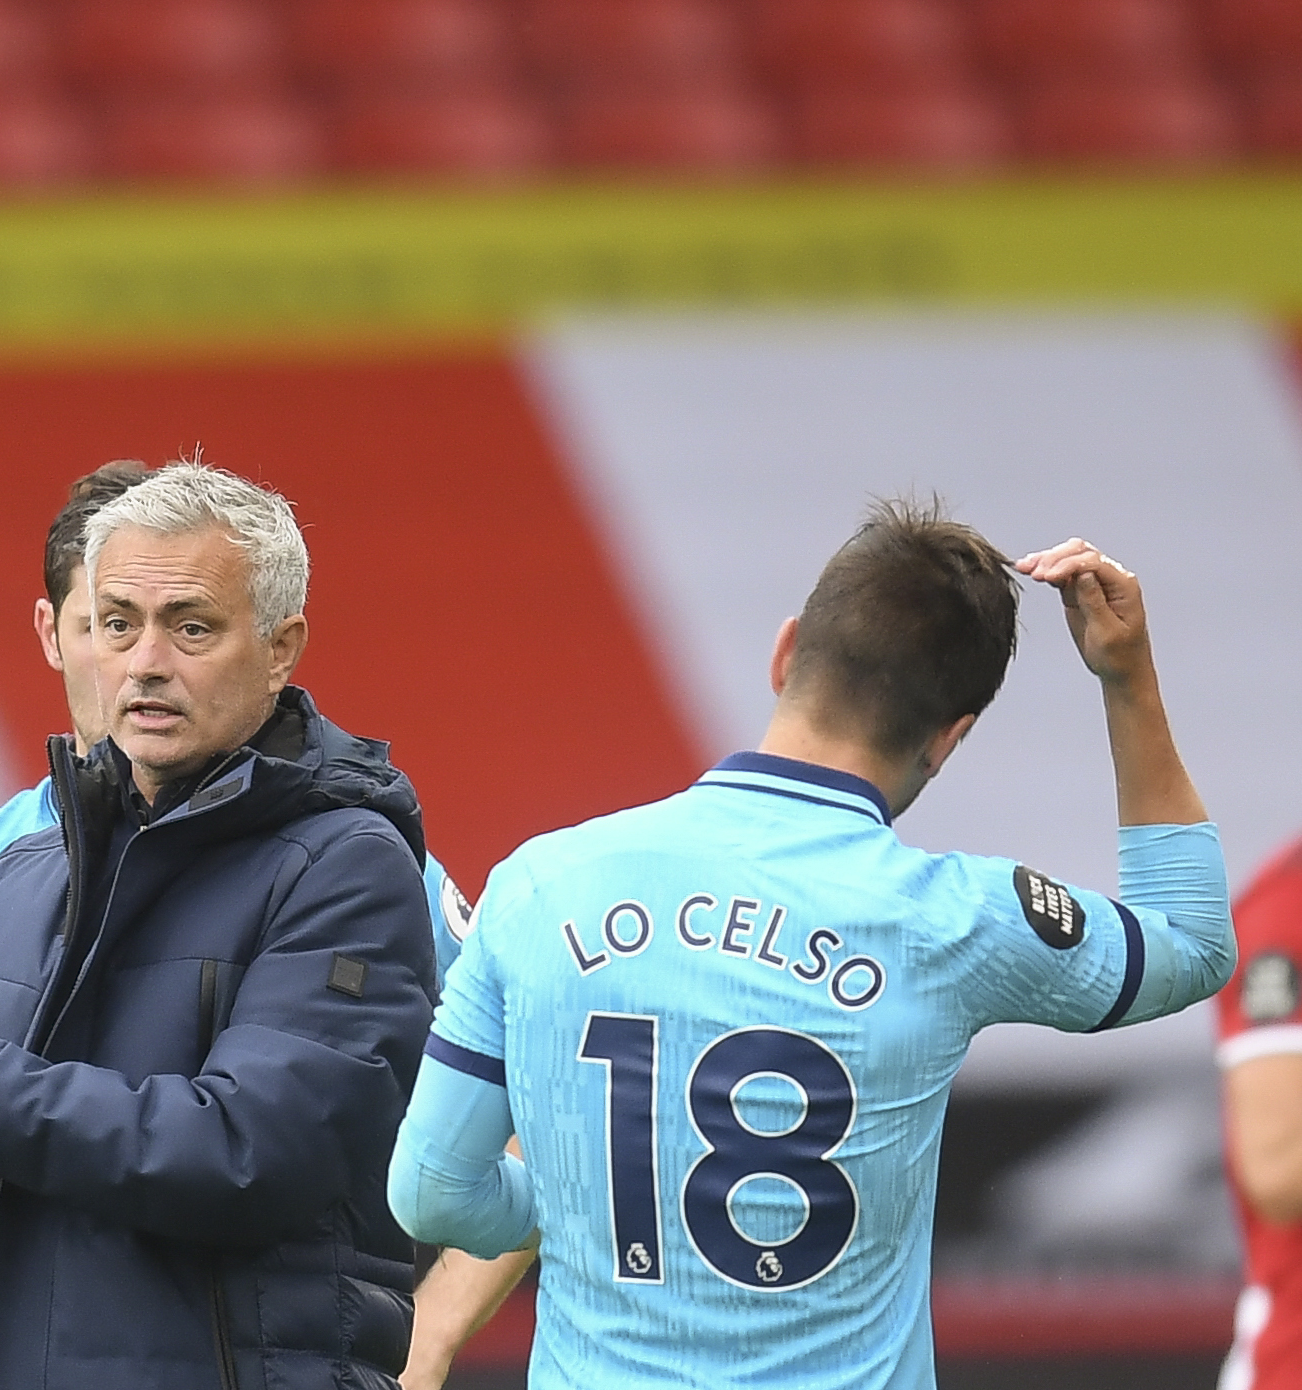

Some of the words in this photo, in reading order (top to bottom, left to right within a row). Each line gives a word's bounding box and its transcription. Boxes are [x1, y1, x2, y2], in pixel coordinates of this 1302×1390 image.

[560, 898, 656, 976] LO
[675, 892, 888, 1012] CELSO
[576, 1010, 860, 1293] 18
